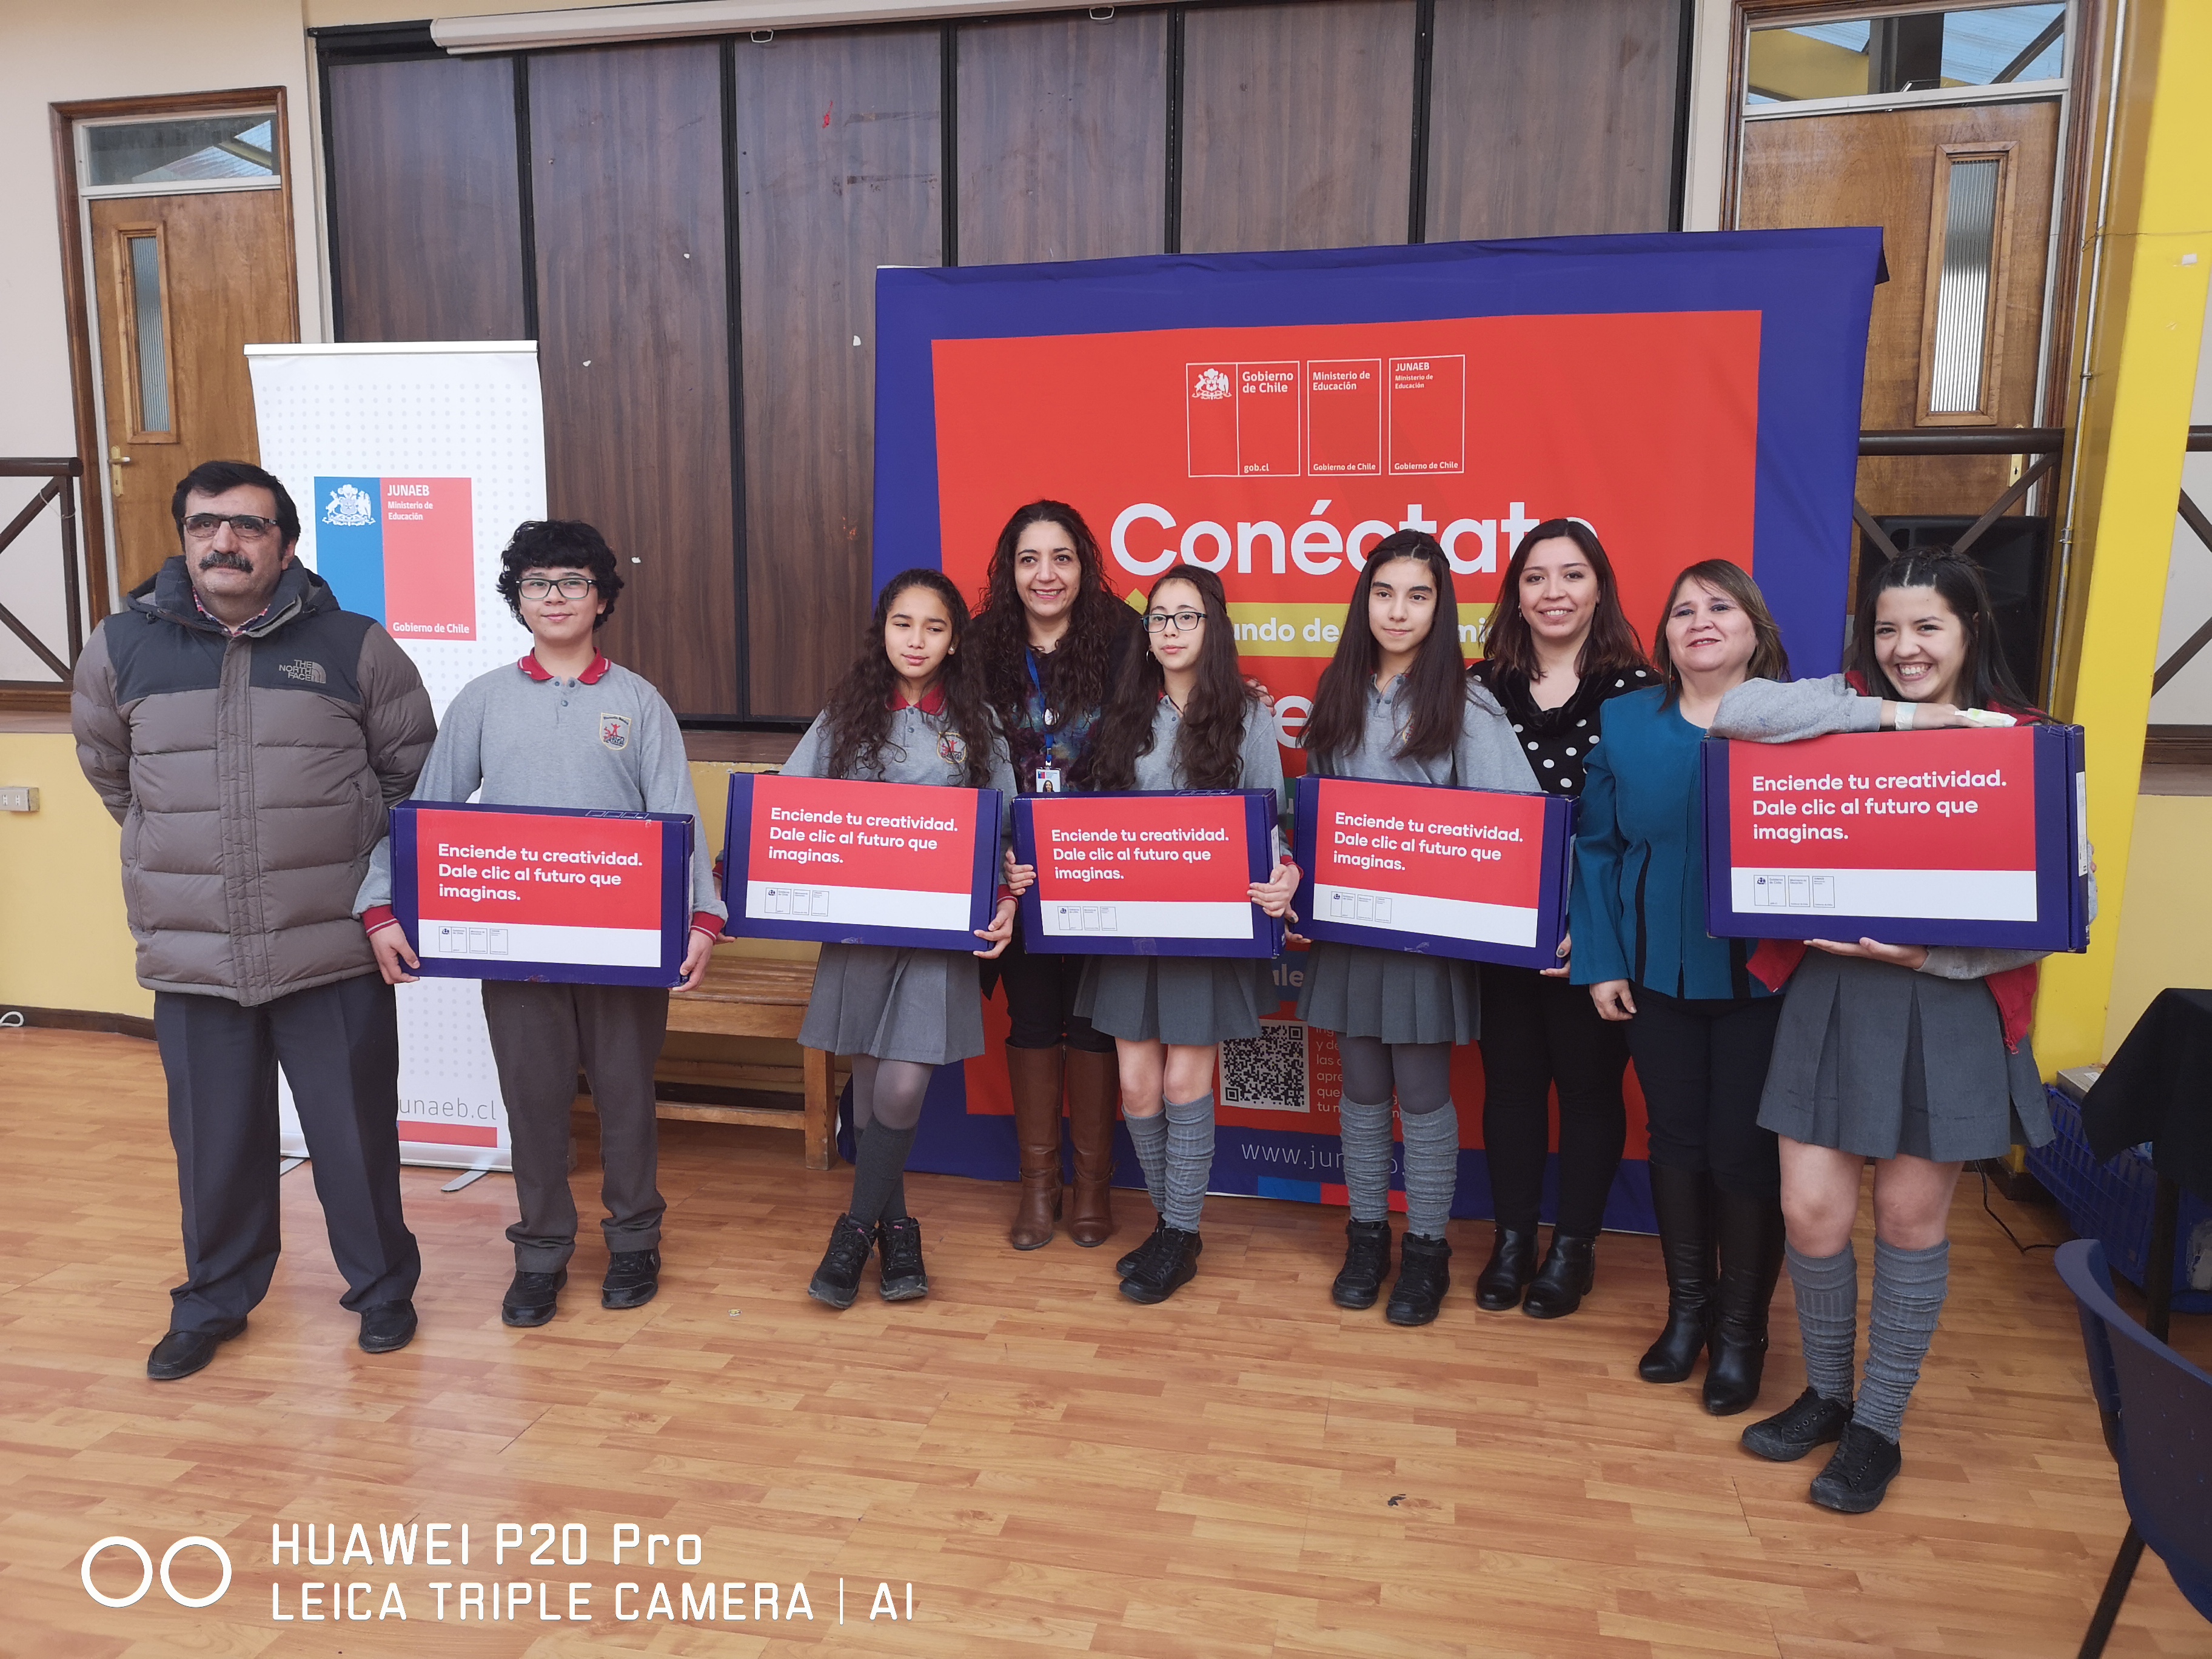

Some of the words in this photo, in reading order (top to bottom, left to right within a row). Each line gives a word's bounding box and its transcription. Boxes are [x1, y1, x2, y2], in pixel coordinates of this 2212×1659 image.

[1395, 362, 1430, 372] JUNAEB
[1242, 370, 1294, 382] Gobierno
[1313, 371, 1357, 380] Ministerio
[1359, 370, 1370, 380] de
[1242, 382, 1257, 394] de
[1259, 381, 1288, 393] Chile
[1313, 381, 1357, 391] Educación
[1244, 463, 1270, 474] gob.cl
[1313, 463, 1346, 471] Gobierno
[387, 484, 430, 497] JUNAEB
[387, 501, 423, 509] Ministerio
[424, 501, 433, 509] de
[388, 511, 424, 520] Educación
[392, 622, 433, 632] Gobierno
[434, 623, 445, 633] de
[446, 623, 470, 634] Chile
[1302, 617, 1340, 642] de
[278, 665, 312, 674] NORTH
[294, 659, 313, 668] THE
[287, 672, 312, 682] FACE
[1752, 774, 1843, 792] Enciende
[1848, 774, 1869, 790] tu
[1875, 769, 2007, 789] creatividad.
[1753, 799, 1797, 816] Dale
[1801, 799, 1836, 816] clic
[1840, 797, 1860, 815] al
[1865, 797, 1931, 815] futuro
[1936, 800, 1979, 818] que
[771, 807, 843, 825] Enciende
[845, 812, 863, 826] tu
[865, 815, 958, 832] creatividad.
[1335, 811, 1405, 831] Enciende
[1407, 819, 1424, 833] tu
[1427, 823, 1523, 842] creatividad.
[769, 826, 806, 842] Dale
[808, 829, 836, 843] clic
[839, 831, 854, 845] al
[856, 831, 905, 848] futuro
[908, 838, 938, 852] que
[1051, 828, 1118, 842] Enciende
[1120, 829, 1136, 842] tu
[1139, 828, 1229, 842] creatividad.
[1753, 823, 1849, 844] imaginas.
[1334, 831, 1369, 847] Dale
[1371, 835, 1398, 850] clic
[1400, 838, 1415, 852] al
[1418, 839, 1467, 857] futuro
[1470, 848, 1502, 862] que
[438, 843, 517, 860] Enciende
[520, 847, 538, 861] tu
[542, 851, 643, 866] creatividad.
[768, 845, 844, 865] imaginas.
[1053, 847, 1086, 861] Dale
[1088, 847, 1114, 861] clic
[1116, 847, 1131, 860] al
[1133, 847, 1179, 861] futuro
[1182, 851, 1212, 864] que
[1333, 850, 1406, 871] imaginas.
[438, 863, 478, 879] Dale
[481, 865, 511, 880] clic
[514, 867, 530, 881] al
[533, 868, 586, 884] futuro
[589, 874, 622, 888] que
[1054, 866, 1124, 882] imaginas.
[439, 883, 521, 902] imaginas.
[1316, 1041, 1324, 1051] y
[1316, 1054, 1334, 1065] las
[1317, 1088, 1340, 1098] que
[399, 1098, 496, 1120] unaeb.cl
[1318, 1102, 1330, 1112] tu
